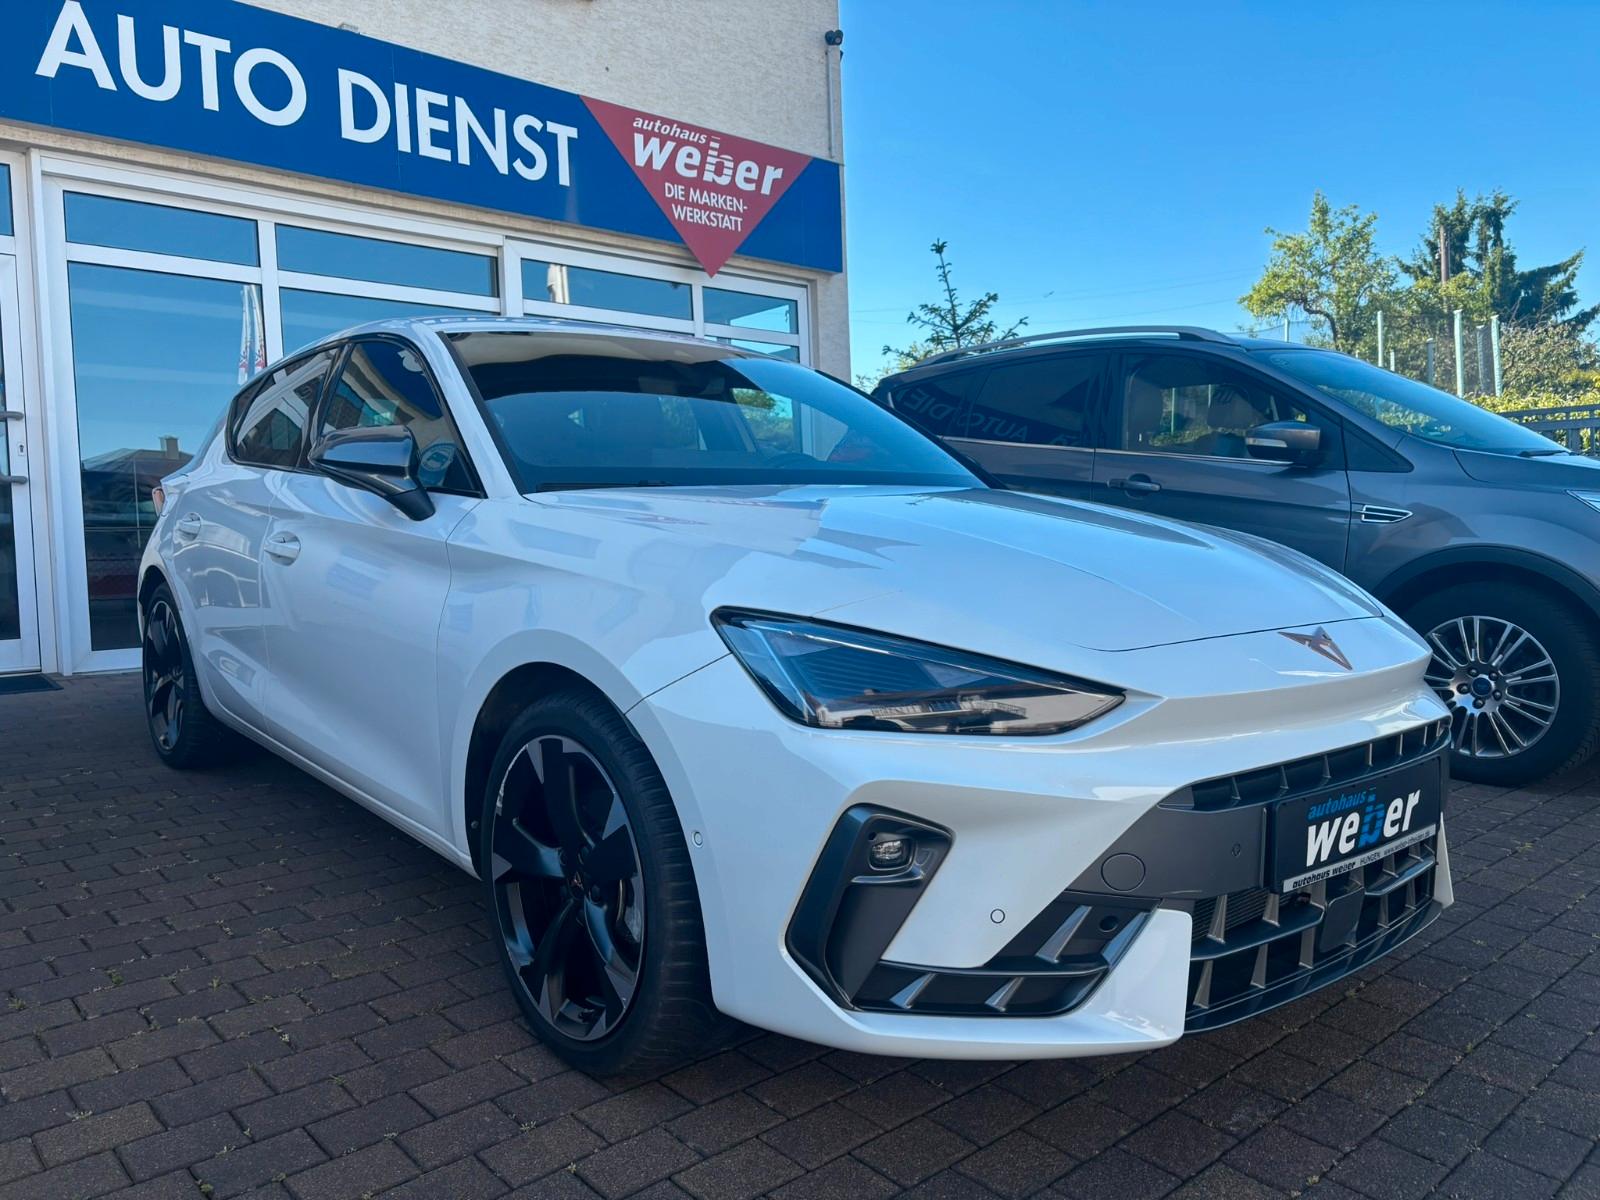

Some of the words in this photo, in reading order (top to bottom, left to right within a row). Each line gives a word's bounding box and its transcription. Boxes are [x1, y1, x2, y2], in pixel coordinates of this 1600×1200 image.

[35, 0, 307, 126] AUTO
[338, 68, 578, 187] DIENST
[633, 117, 707, 144] autohaus
[633, 133, 783, 195] weber
[664, 182, 685, 200] DIE
[689, 187, 748, 213] MARKEN-
[671, 204, 743, 232] WERKSTATT
[1307, 790, 1366, 820] autohaus
[1306, 787, 1421, 867] weber
[1292, 870, 1331, 889] autohaus
[1332, 861, 1356, 876] weber
